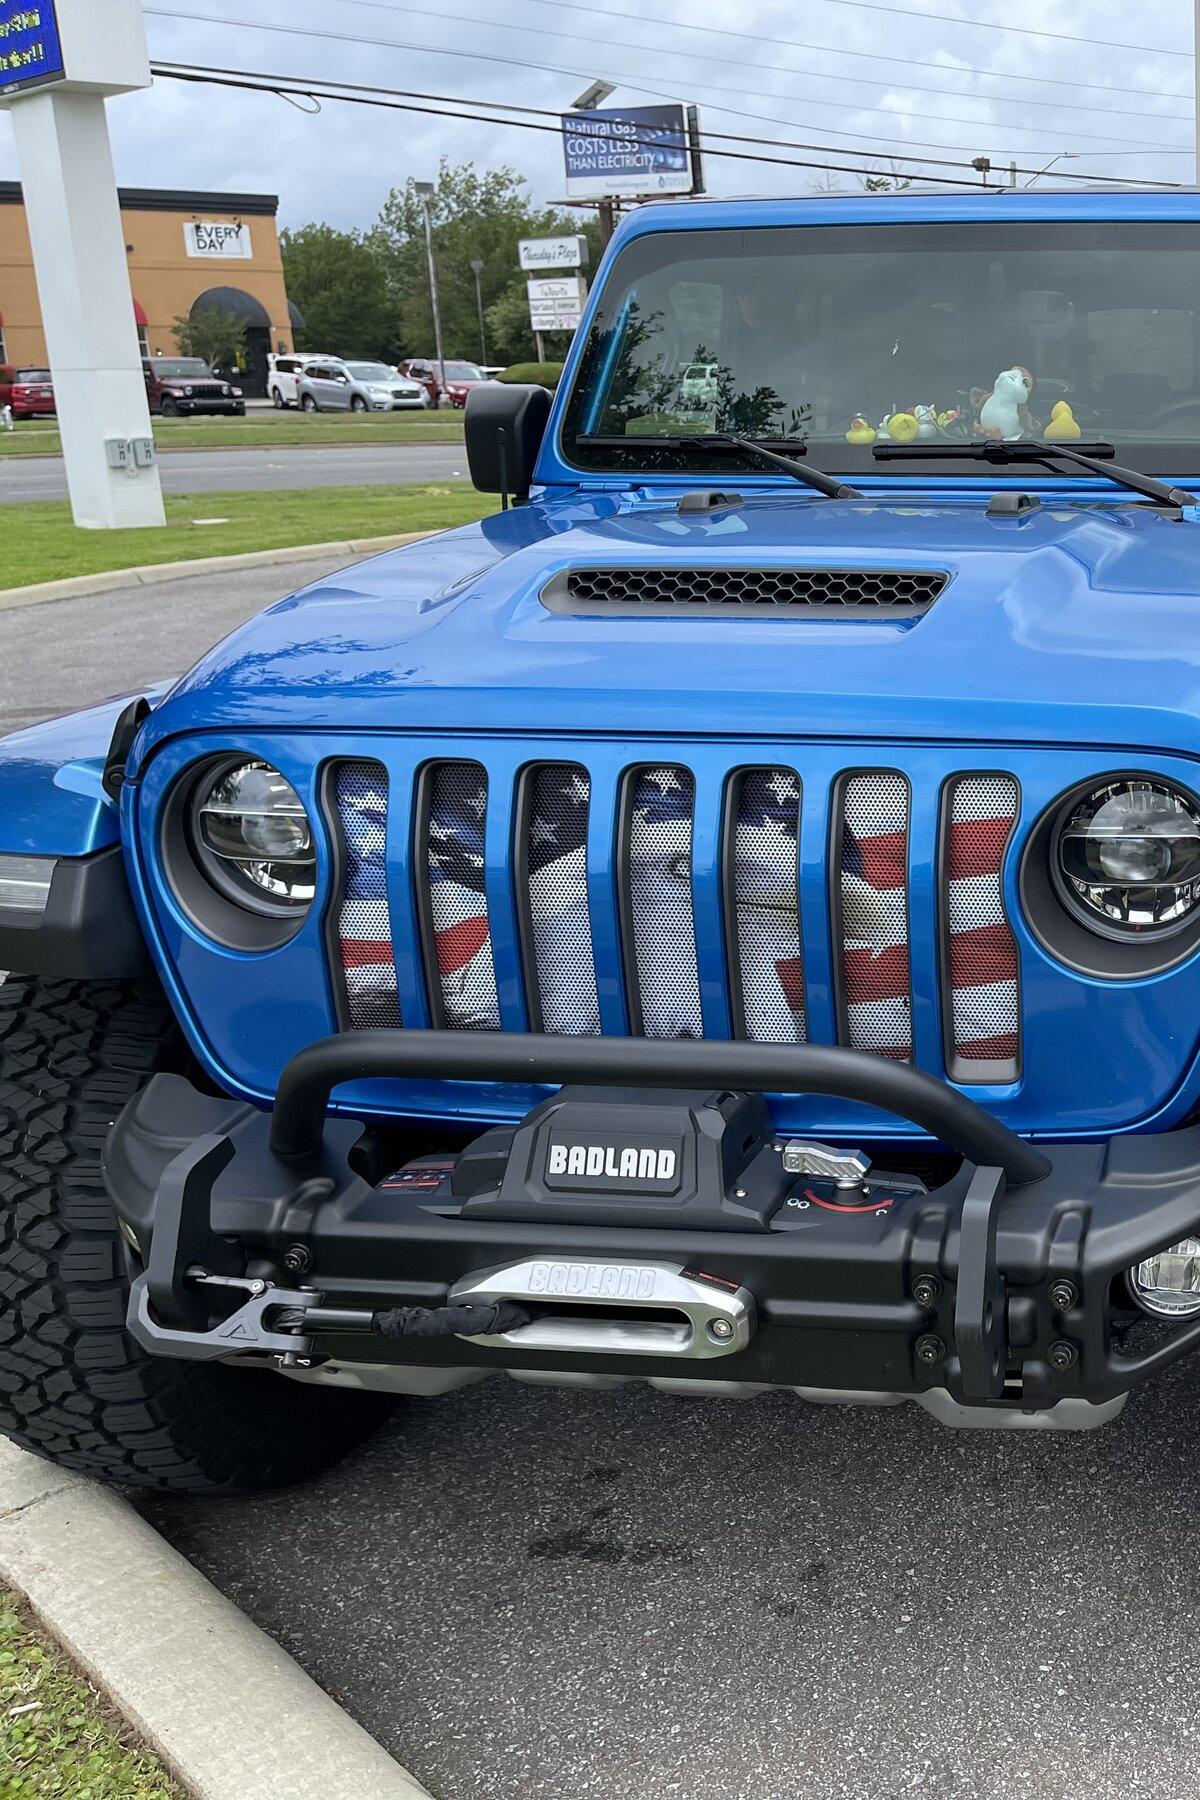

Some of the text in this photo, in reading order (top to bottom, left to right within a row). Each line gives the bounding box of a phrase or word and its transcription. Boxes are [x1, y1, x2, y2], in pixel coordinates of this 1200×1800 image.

[566, 118, 637, 137] Natural Gas
[566, 135, 639, 155] COSTS LESS
[568, 156, 598, 170] THAN
[195, 225, 241, 239] EVERY
[196, 238, 225, 250] DAY
[549, 1144, 677, 1179] BADLAND
[528, 1262, 657, 1299] BADLAND
